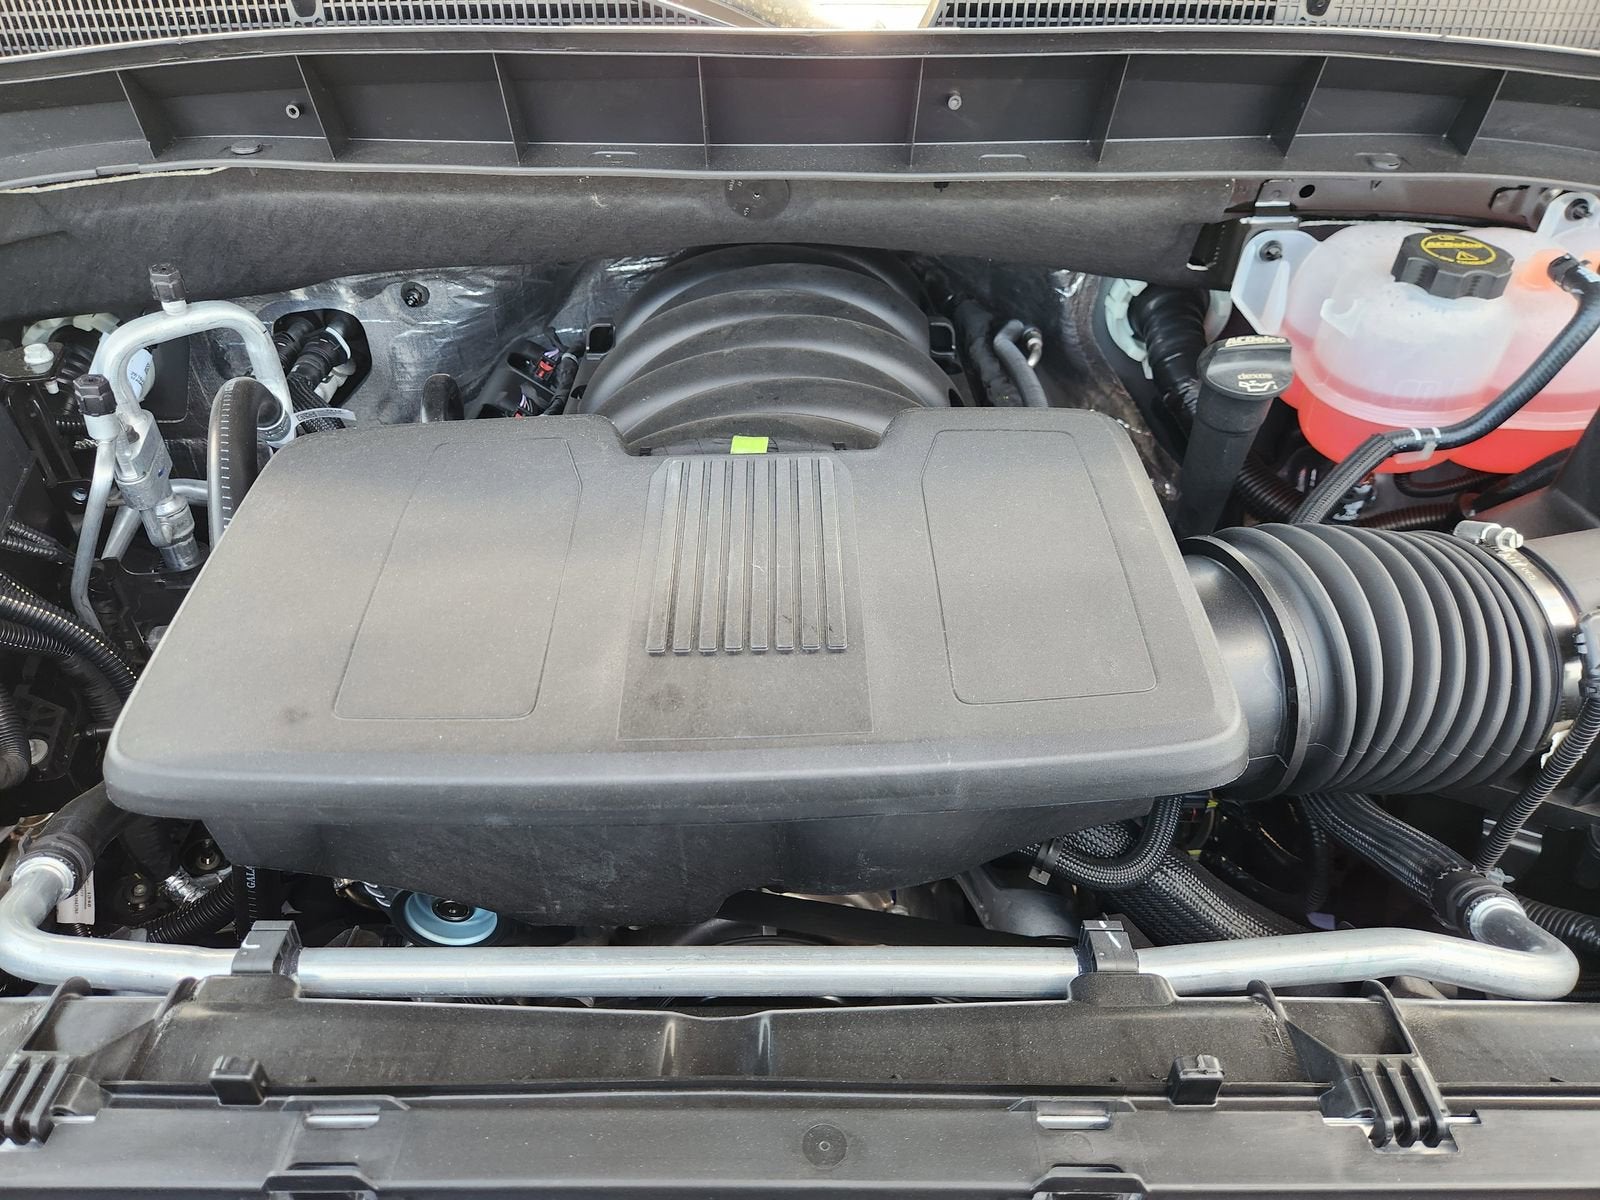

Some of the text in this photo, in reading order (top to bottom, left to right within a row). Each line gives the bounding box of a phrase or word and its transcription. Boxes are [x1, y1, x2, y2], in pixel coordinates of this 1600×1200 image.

[1424, 241, 1485, 249] ACDelco
[1225, 336, 1287, 347] ACDelco
[1237, 372, 1274, 380] dexos
